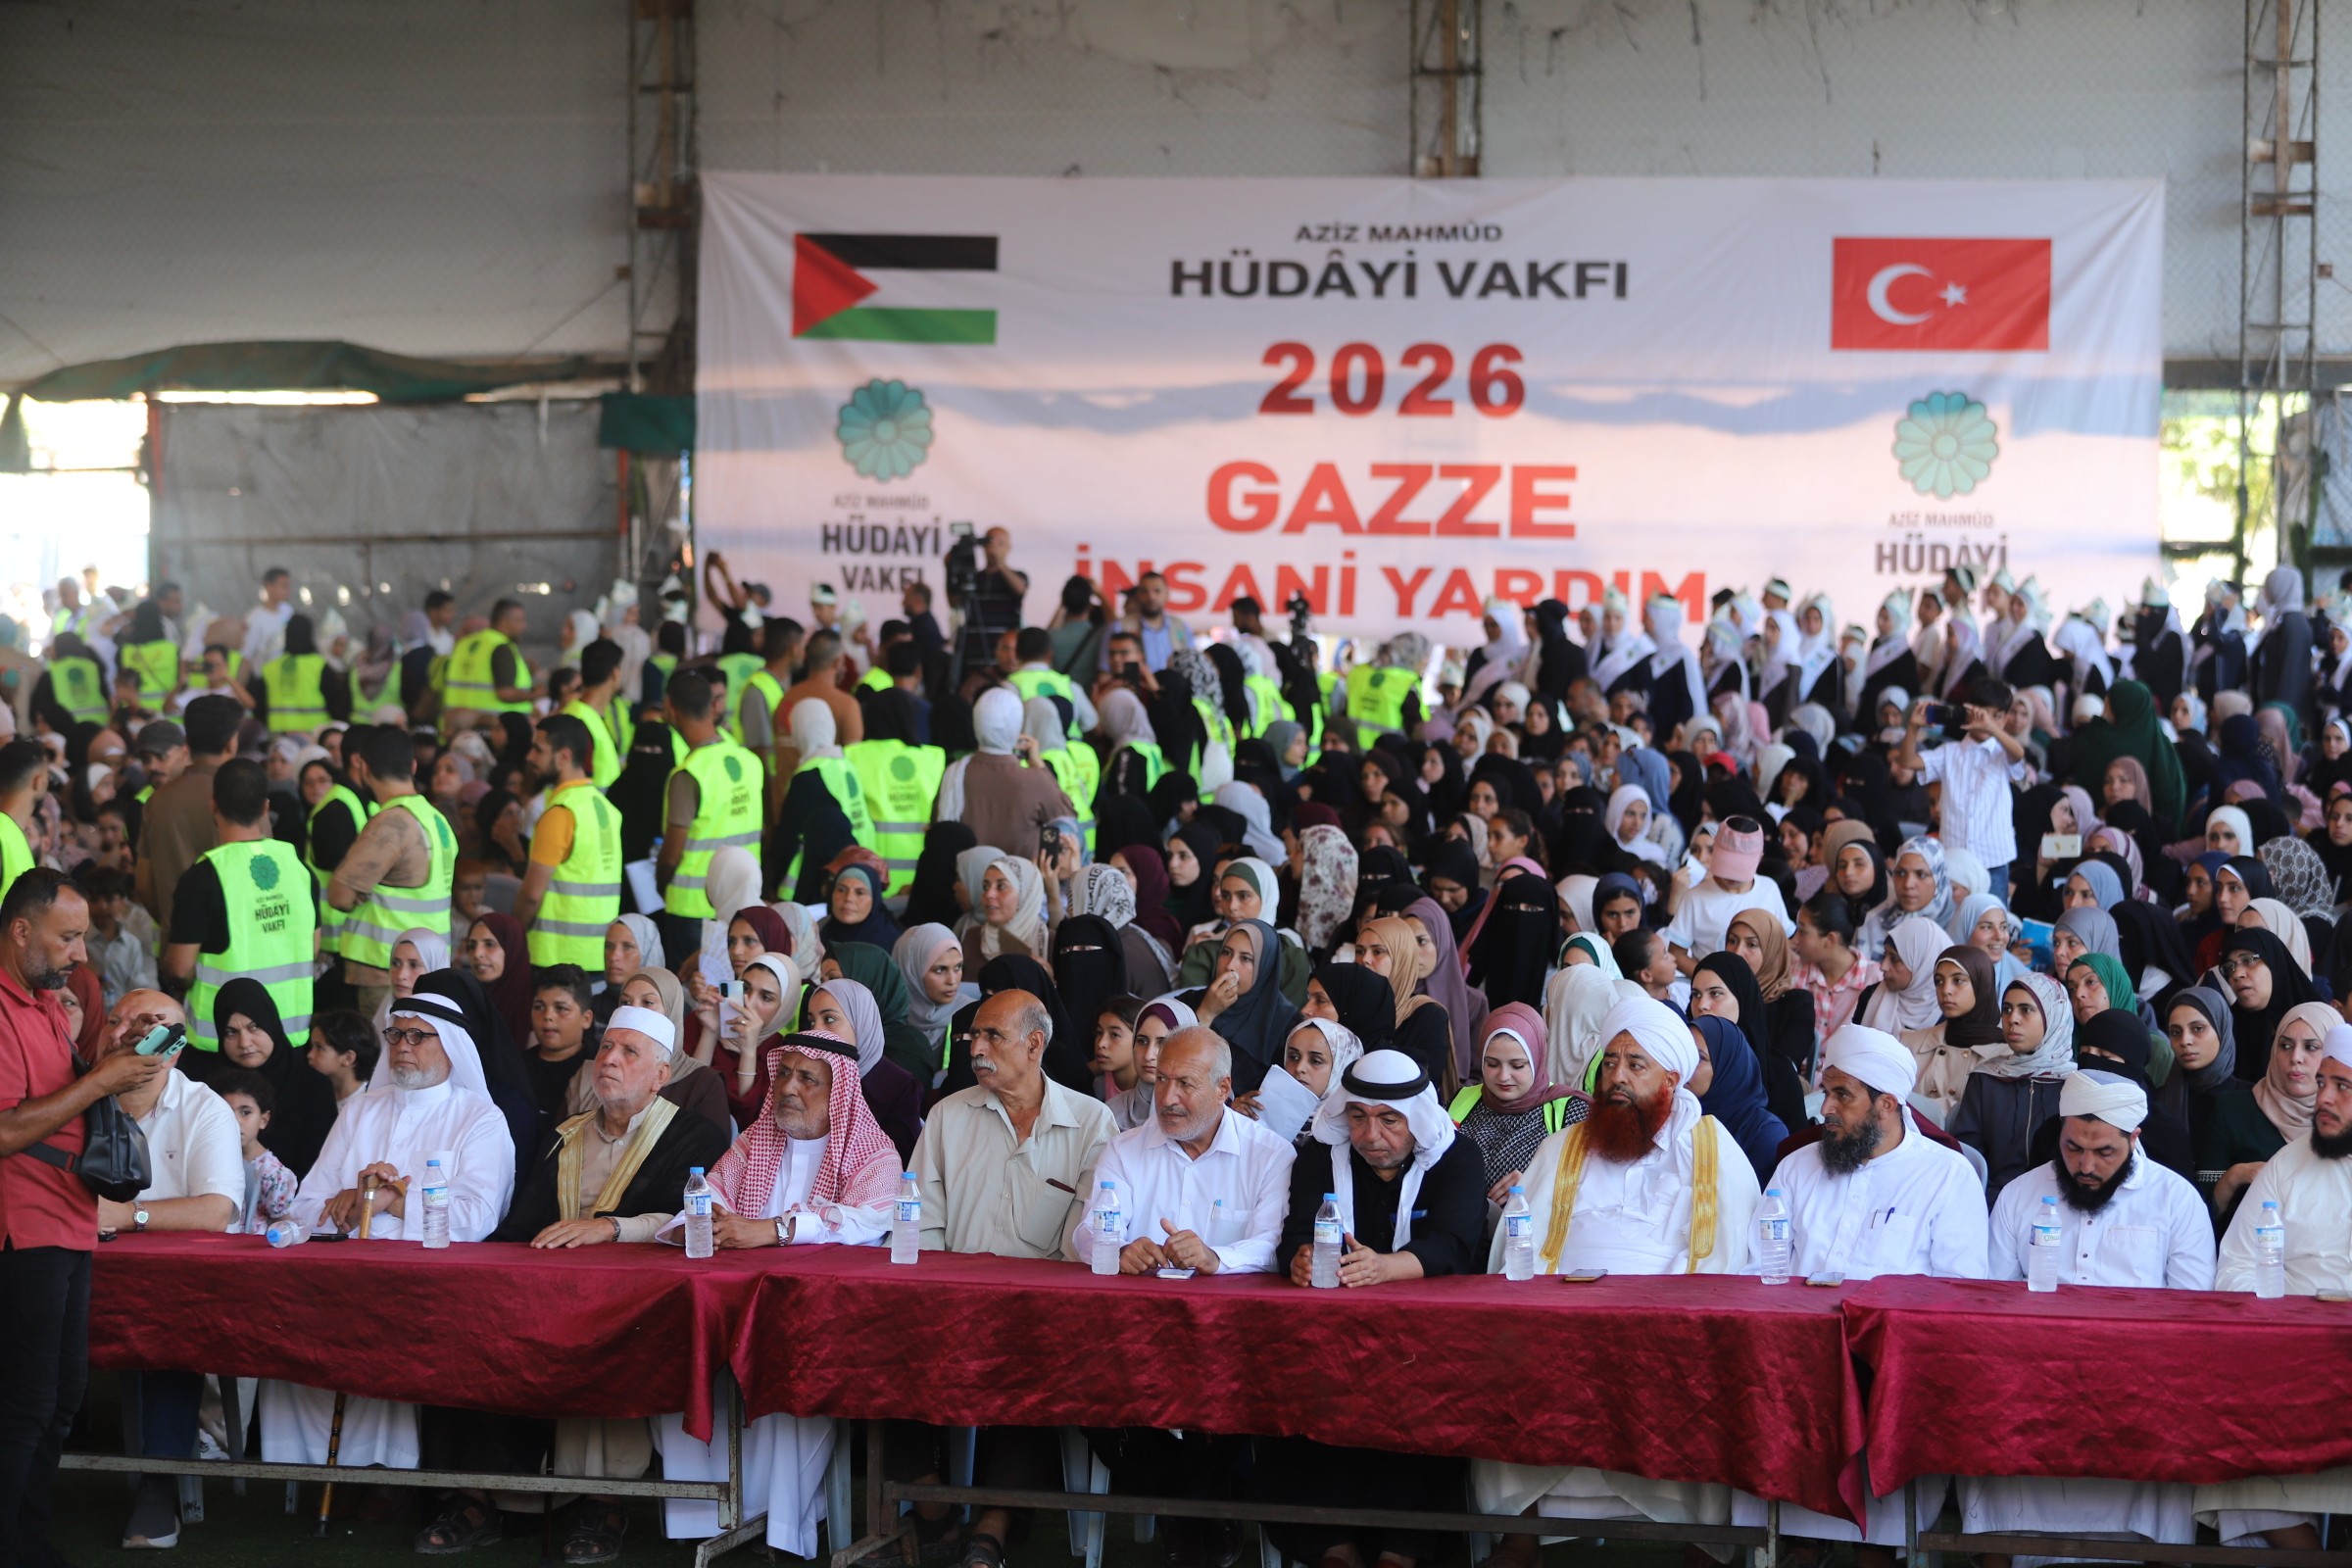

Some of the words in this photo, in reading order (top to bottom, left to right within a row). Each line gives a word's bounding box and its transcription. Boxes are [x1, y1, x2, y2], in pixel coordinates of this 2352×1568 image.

[1295, 223, 1359, 243] AZİZ
[1171, 250, 1418, 298] HÜDÂYİ
[1436, 261, 1628, 299] VAKFI
[1258, 341, 1525, 417] 2026
[1206, 462, 1578, 538] GAZZE
